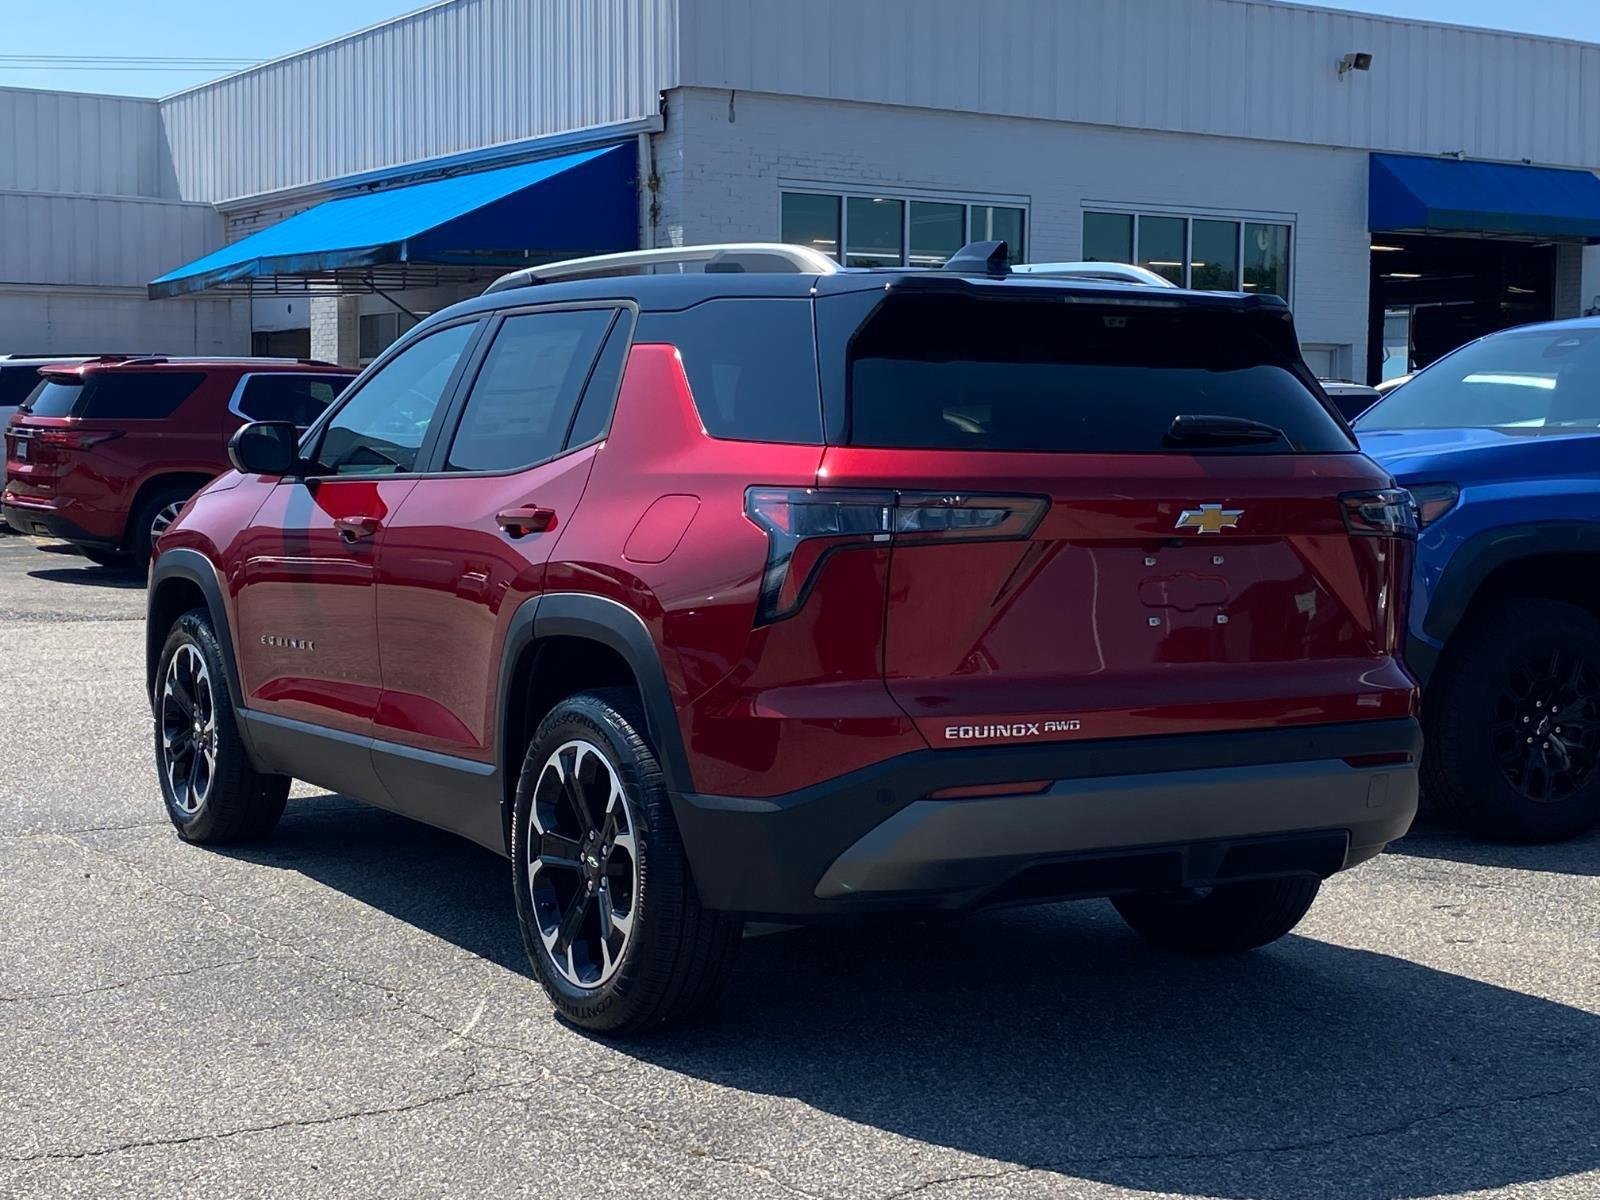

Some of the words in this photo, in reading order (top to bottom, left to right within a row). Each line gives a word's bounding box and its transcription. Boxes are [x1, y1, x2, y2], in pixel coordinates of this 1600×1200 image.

[260, 635, 315, 651] EQUINOX
[945, 723, 1039, 738] EQUINOX
[1044, 720, 1080, 731] AWD
